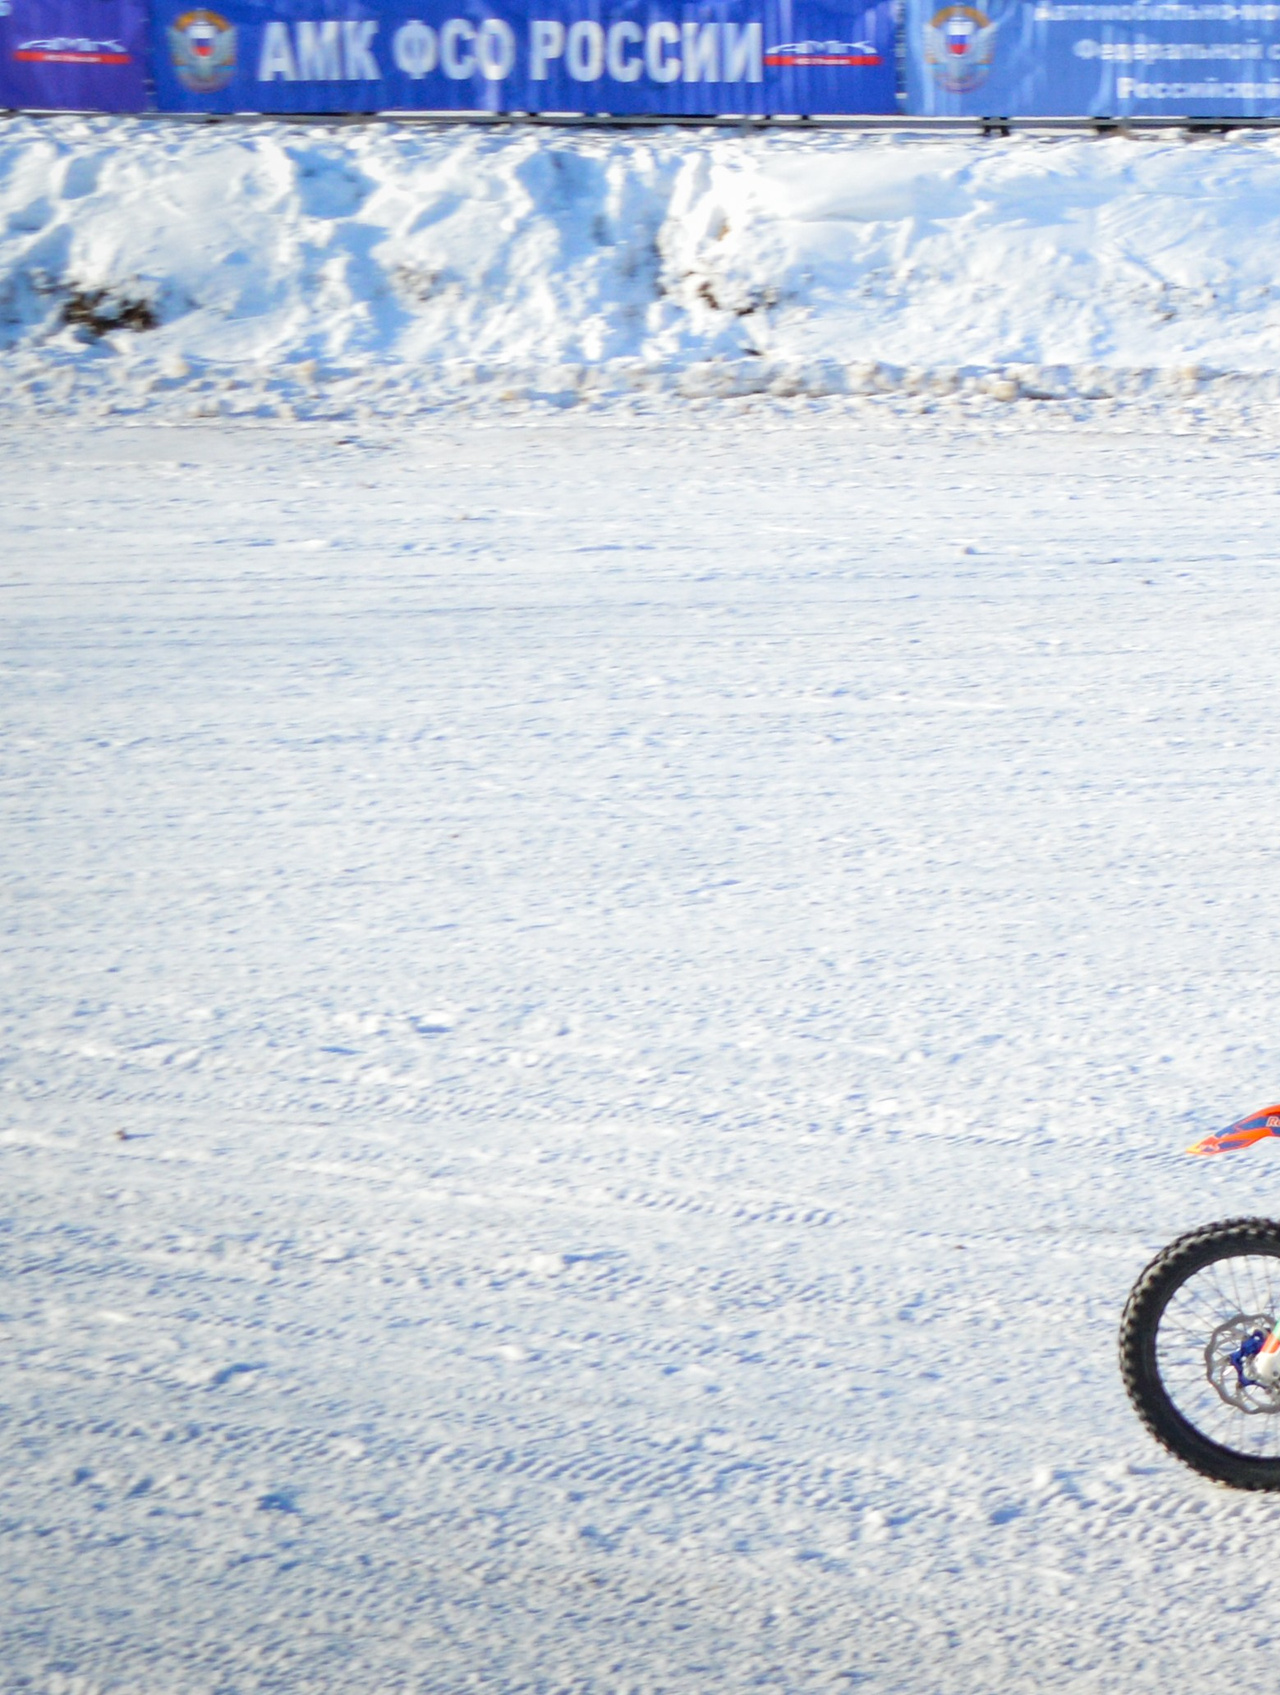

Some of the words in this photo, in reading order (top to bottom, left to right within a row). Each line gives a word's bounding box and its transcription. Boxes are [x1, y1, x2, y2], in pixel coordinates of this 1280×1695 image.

[258, 21, 382, 81] АМК
[393, 19, 516, 81] ФСО
[529, 20, 763, 83] РОССИИ
